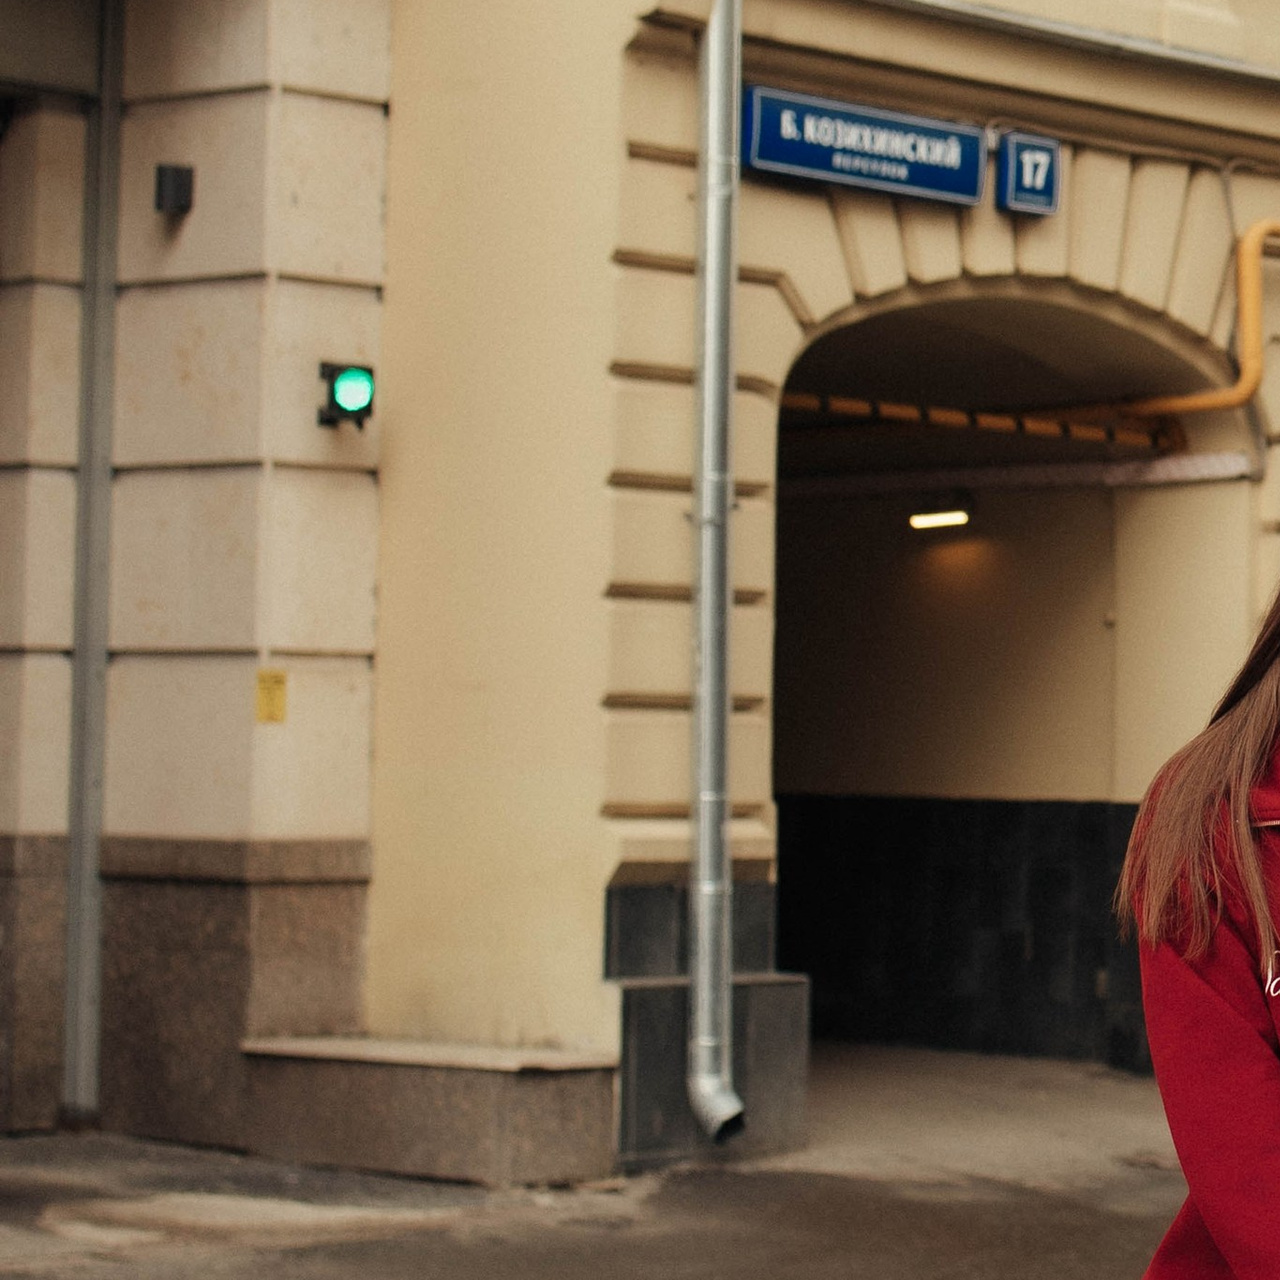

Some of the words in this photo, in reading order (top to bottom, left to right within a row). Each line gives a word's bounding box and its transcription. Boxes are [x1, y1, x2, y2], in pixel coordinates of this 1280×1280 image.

[780, 109, 801, 141] Б.
[803, 114, 962, 170] КОЗИХИНСКИЙ
[1020, 149, 1051, 190] 17
